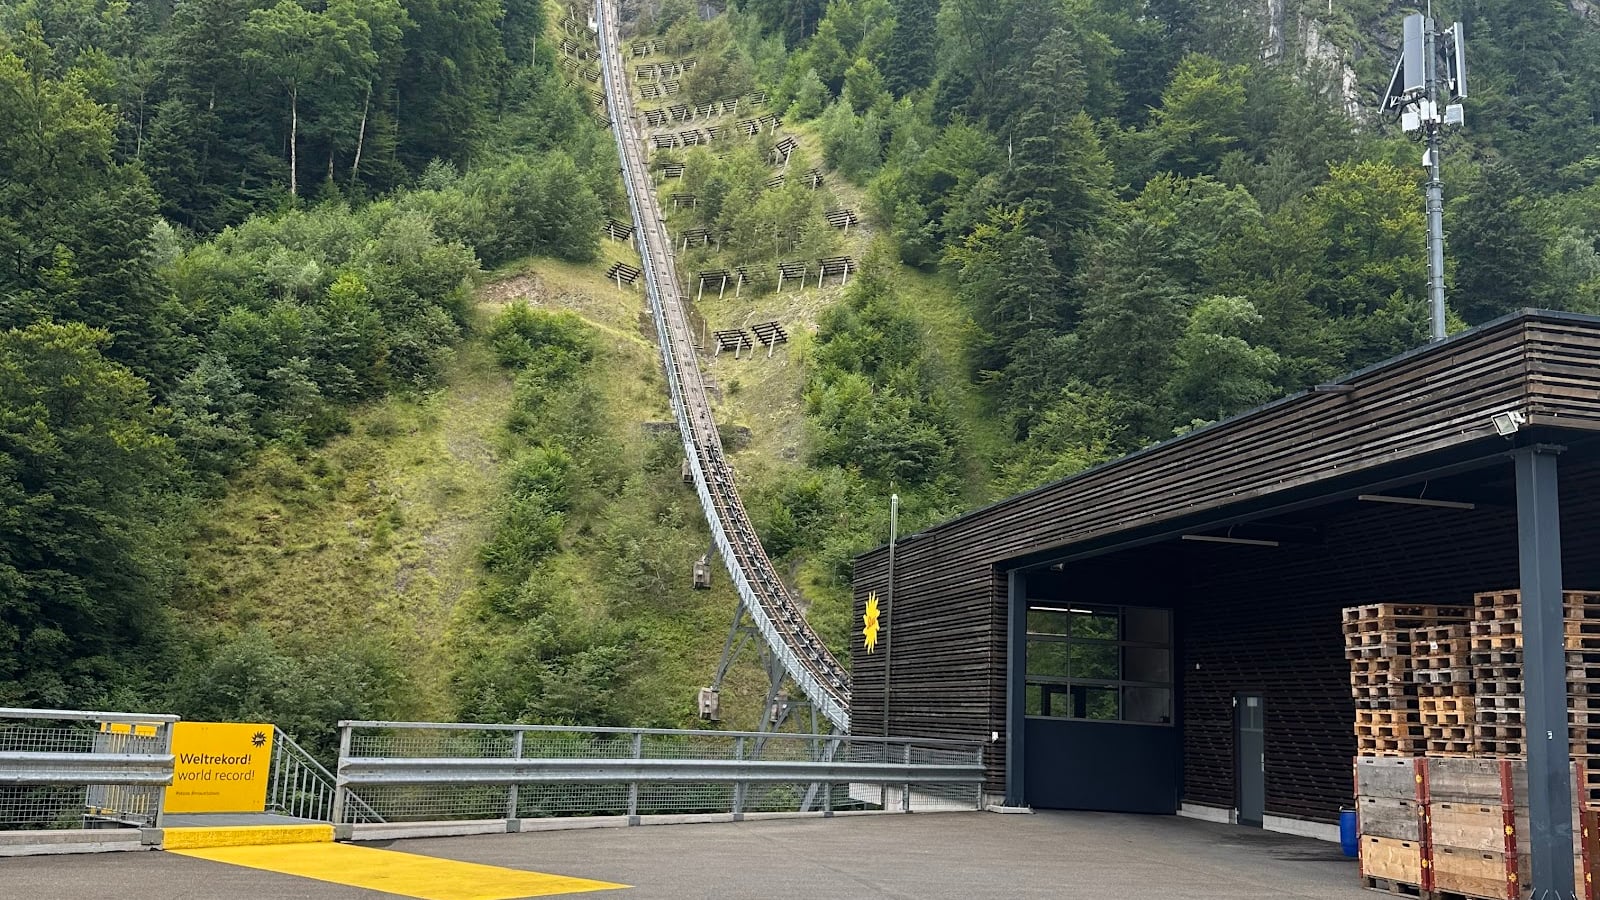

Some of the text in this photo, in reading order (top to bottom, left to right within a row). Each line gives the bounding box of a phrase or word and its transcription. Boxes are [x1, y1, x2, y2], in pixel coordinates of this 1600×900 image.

[180, 753, 252, 765] Weltrekord!
[178, 769, 255, 781] world record!
